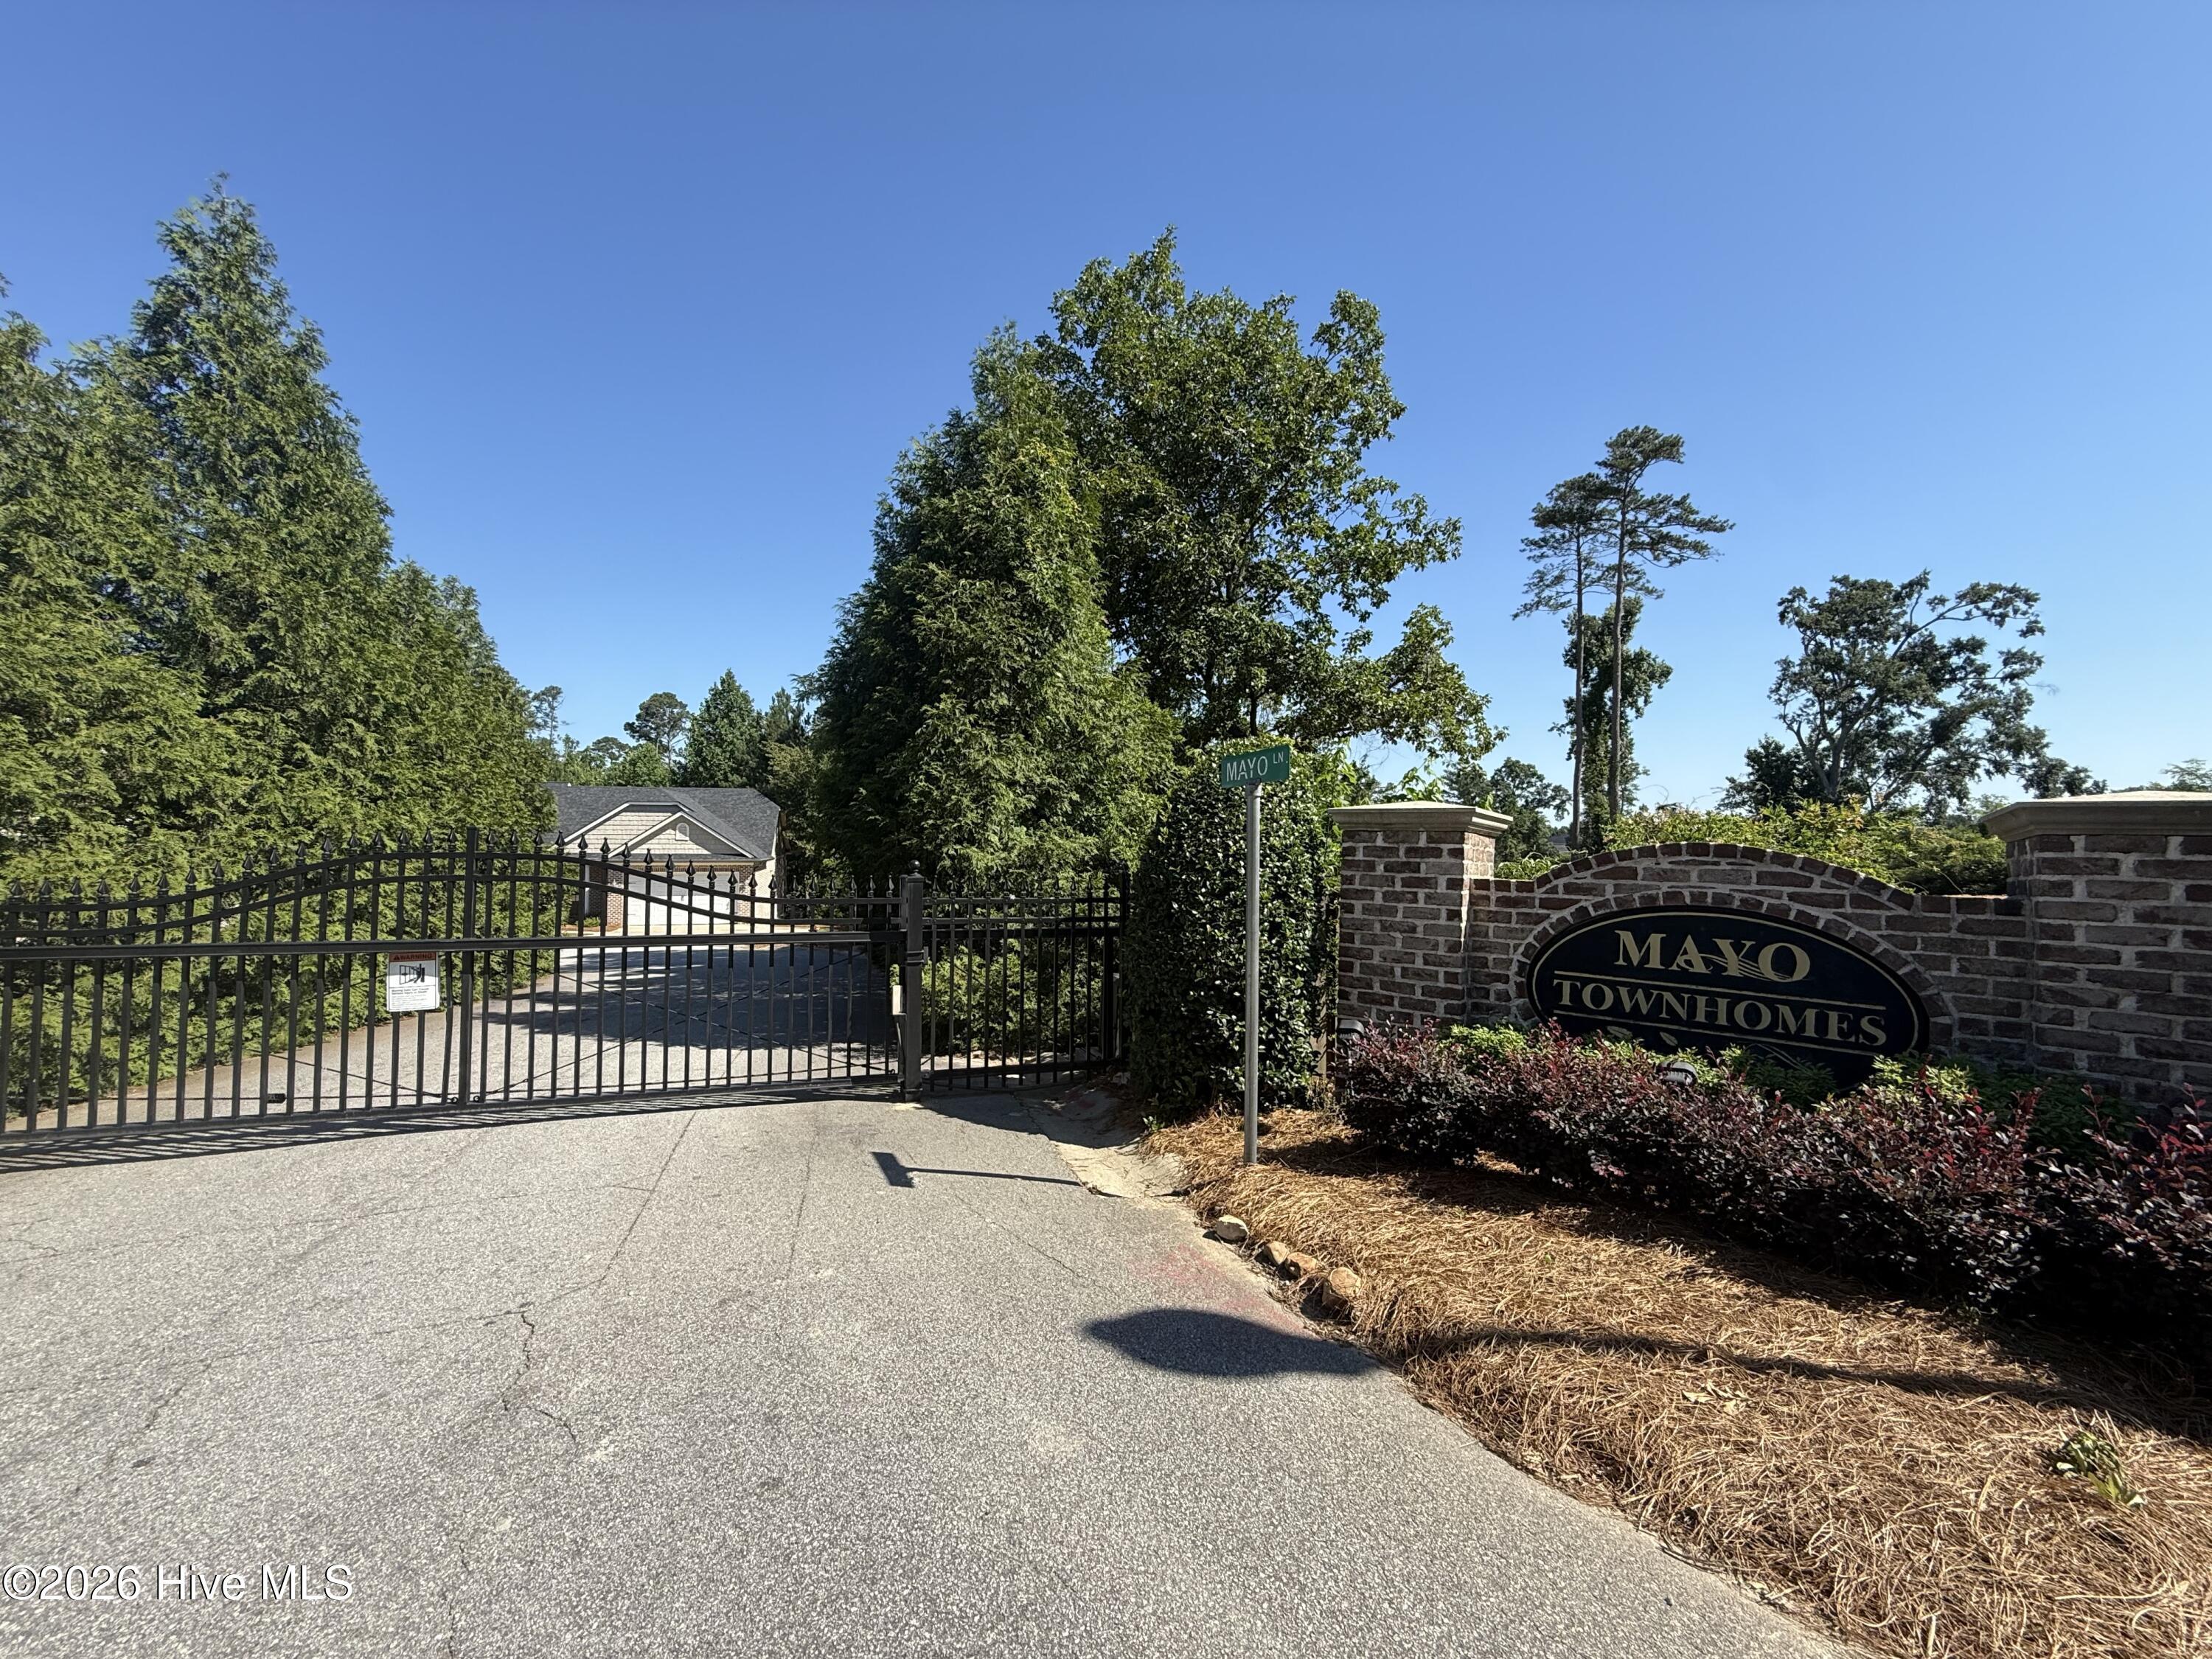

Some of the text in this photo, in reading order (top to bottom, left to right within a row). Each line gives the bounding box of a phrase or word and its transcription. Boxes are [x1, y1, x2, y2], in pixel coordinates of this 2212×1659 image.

[1226, 756, 1268, 782] MAYO
[1614, 930, 1811, 982] MAYO
[1553, 978, 1888, 1046] TOWNHOMES
